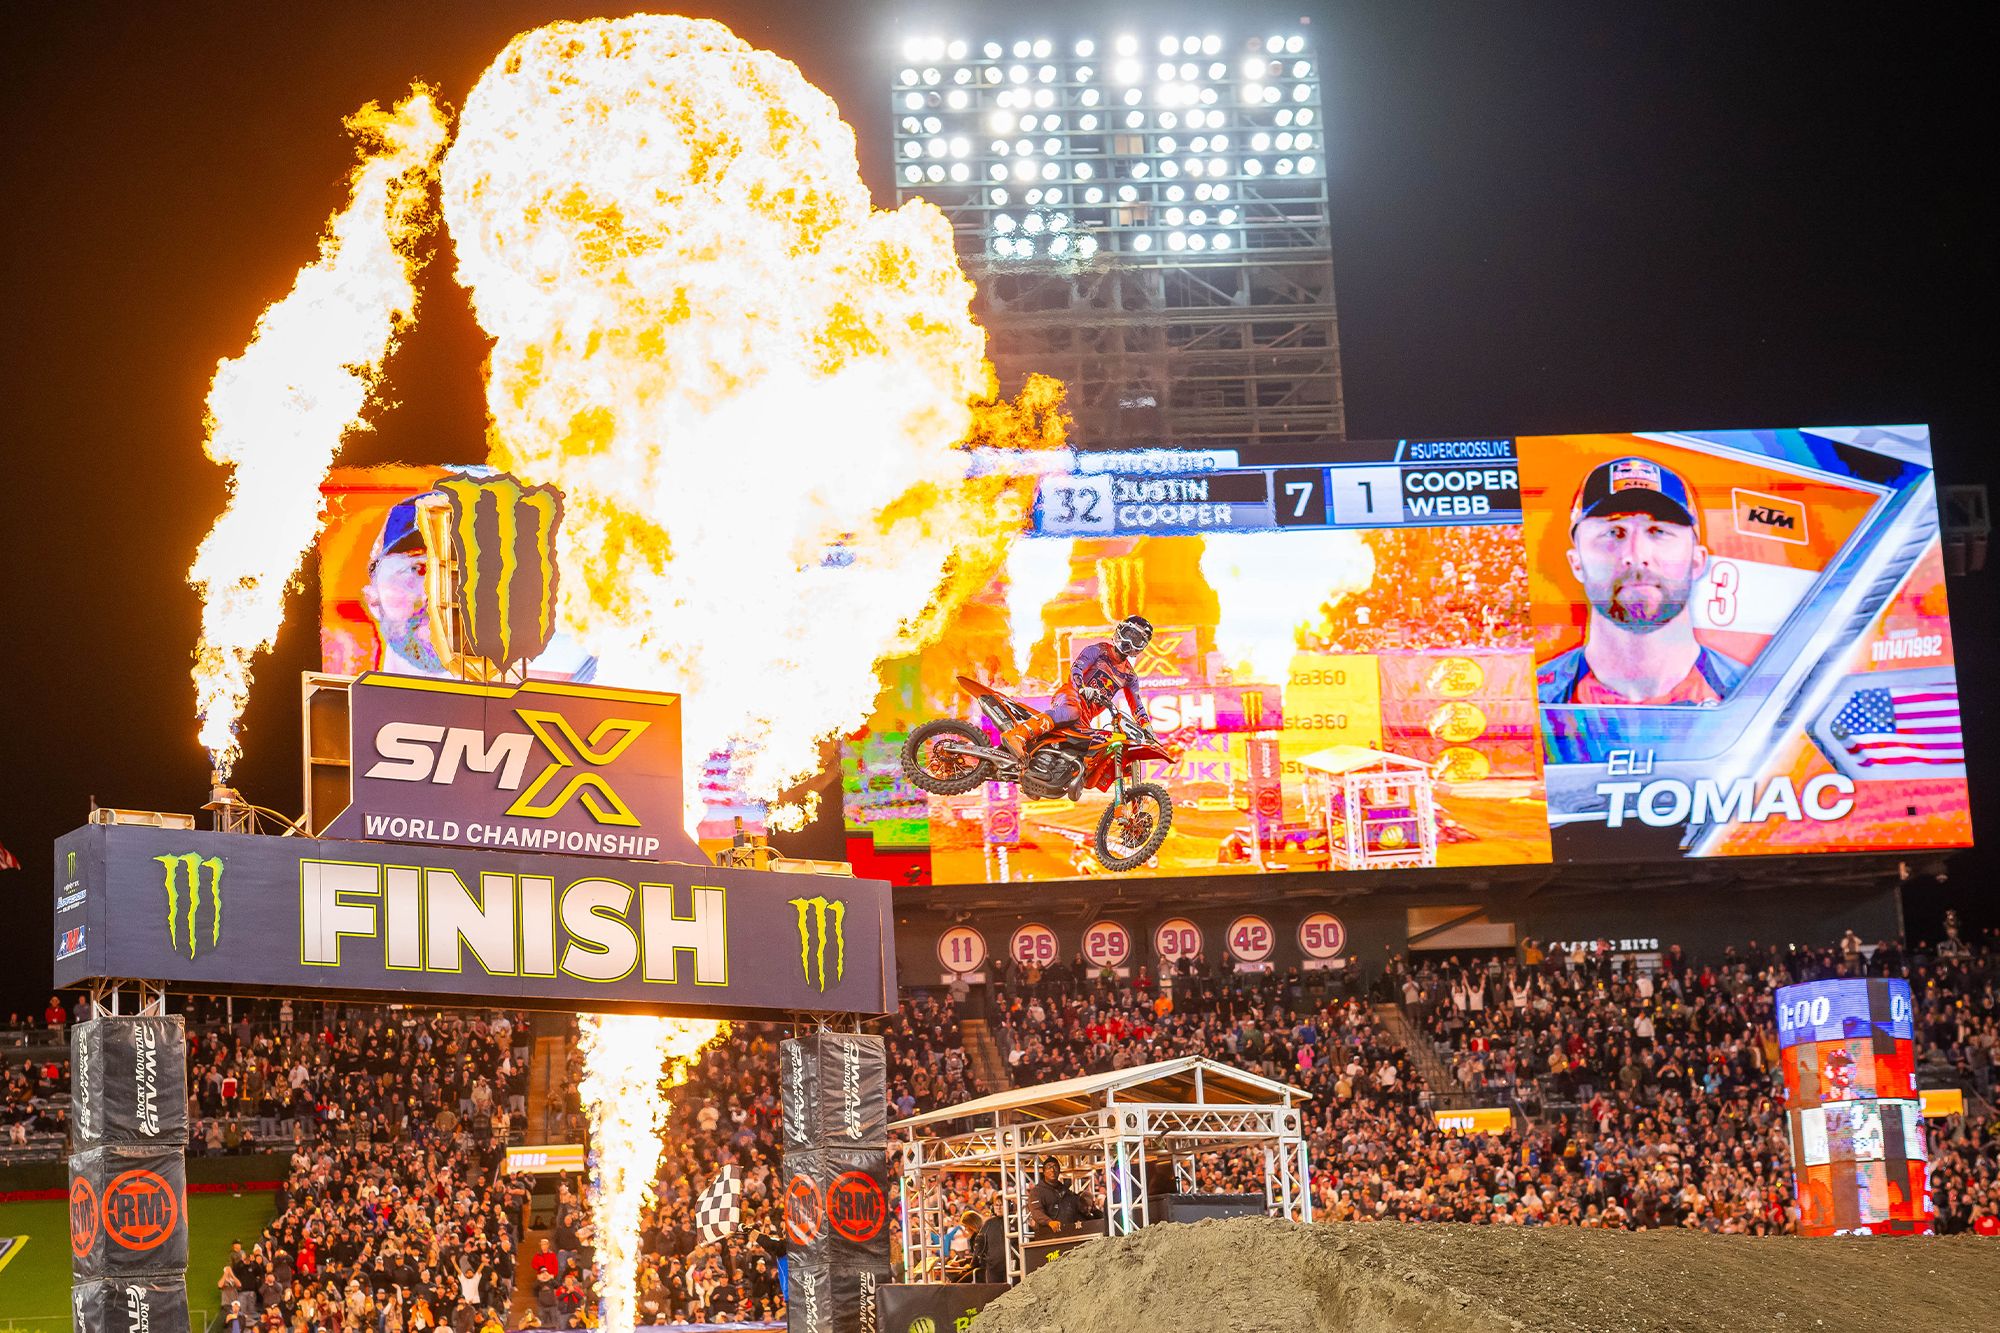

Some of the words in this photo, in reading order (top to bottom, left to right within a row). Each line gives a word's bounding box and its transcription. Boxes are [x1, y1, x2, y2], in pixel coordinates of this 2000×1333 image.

[1411, 441, 1511, 459] #SUPERCROSSLIVE
[1114, 479, 1209, 501] JUSTIN
[1405, 470, 1518, 493] COOPER
[1053, 487, 1101, 523] 32
[1285, 482, 1313, 517] 7
[1358, 482, 1374, 513] 1
[1407, 495, 1490, 517] WEBB
[1118, 503, 1232, 528] COOPER
[1747, 506, 1795, 530] KTM
[1708, 561, 1740, 627] 3
[1872, 635, 1942, 661] 11/14/1992
[364, 708, 652, 827] SMX
[1607, 748, 1653, 776] ELI
[1596, 773, 1855, 828] TOMAC
[366, 814, 459, 842] WORLD
[466, 823, 660, 856] CHAMPIONSHIP
[300, 858, 729, 987] FINISH
[1305, 923, 1339, 948] 50
[951, 937, 972, 963] 11
[1018, 934, 1053, 960] 26
[1090, 932, 1125, 957] 29
[1162, 929, 1196, 954] 30
[1233, 926, 1268, 951] 42
[1620, 938, 1659, 951] HITS
[134, 1025, 145, 1083] MOUNTAIN
[843, 1040, 851, 1093] MOUNTAIN
[136, 1083, 146, 1119] ROCKY
[844, 1093, 852, 1124] ROCKY
[116, 1193, 163, 1227] RM
[839, 1193, 875, 1221] RM
[859, 1271, 867, 1323] MOUNTAIN
